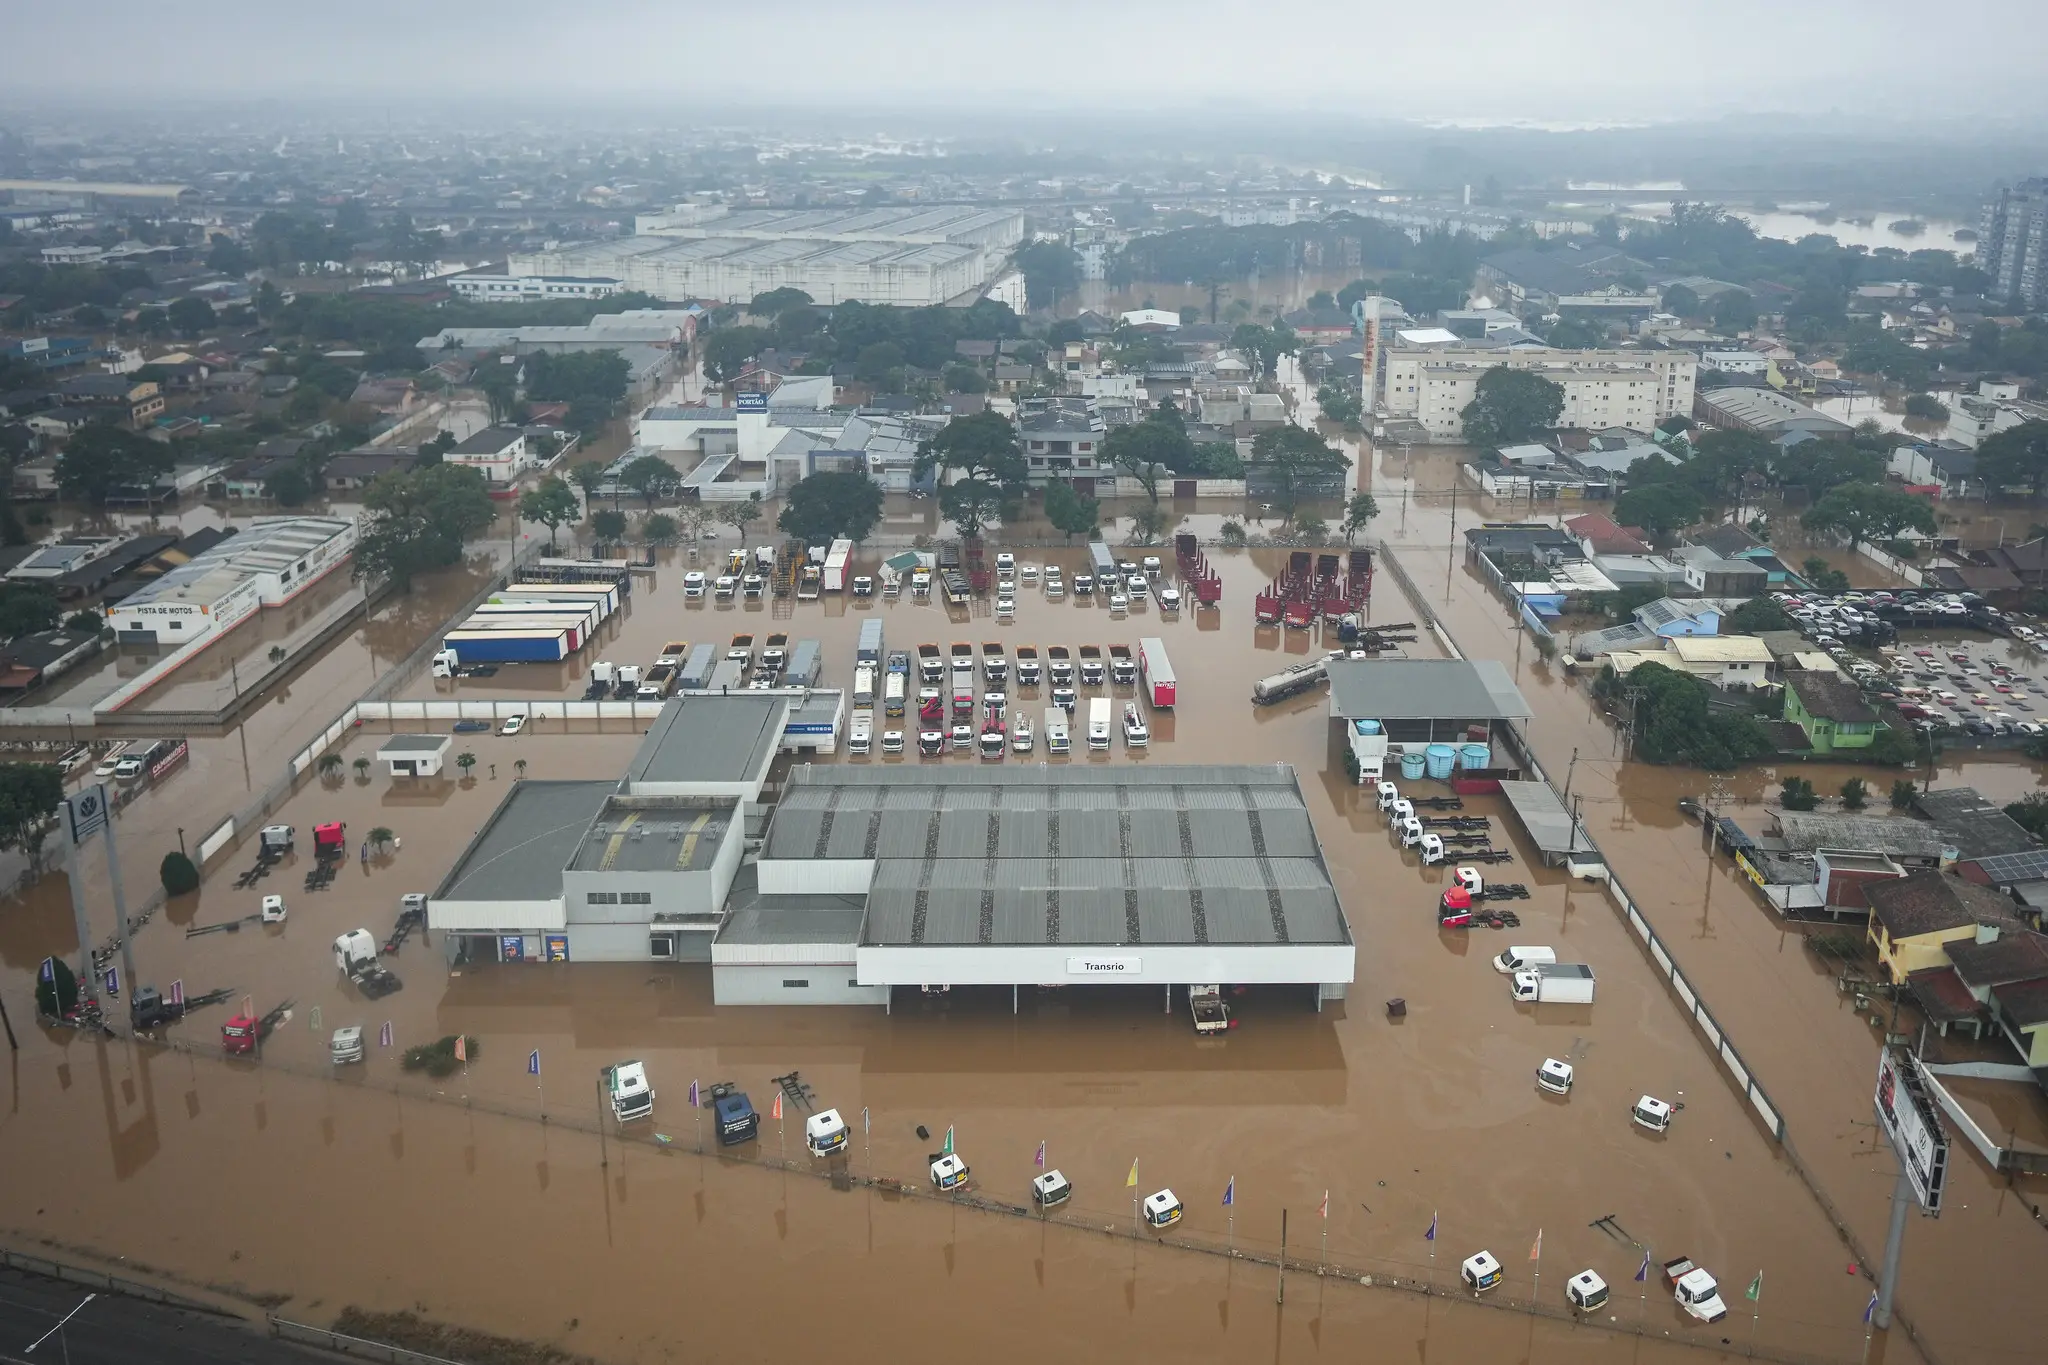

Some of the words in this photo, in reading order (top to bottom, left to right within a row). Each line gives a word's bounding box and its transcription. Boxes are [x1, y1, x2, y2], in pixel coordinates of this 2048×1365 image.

[137, 607, 157, 615] PISTA
[158, 607, 168, 615] DE
[168, 607, 193, 615] MOTOS
[1084, 962, 1125, 971] Transrio
